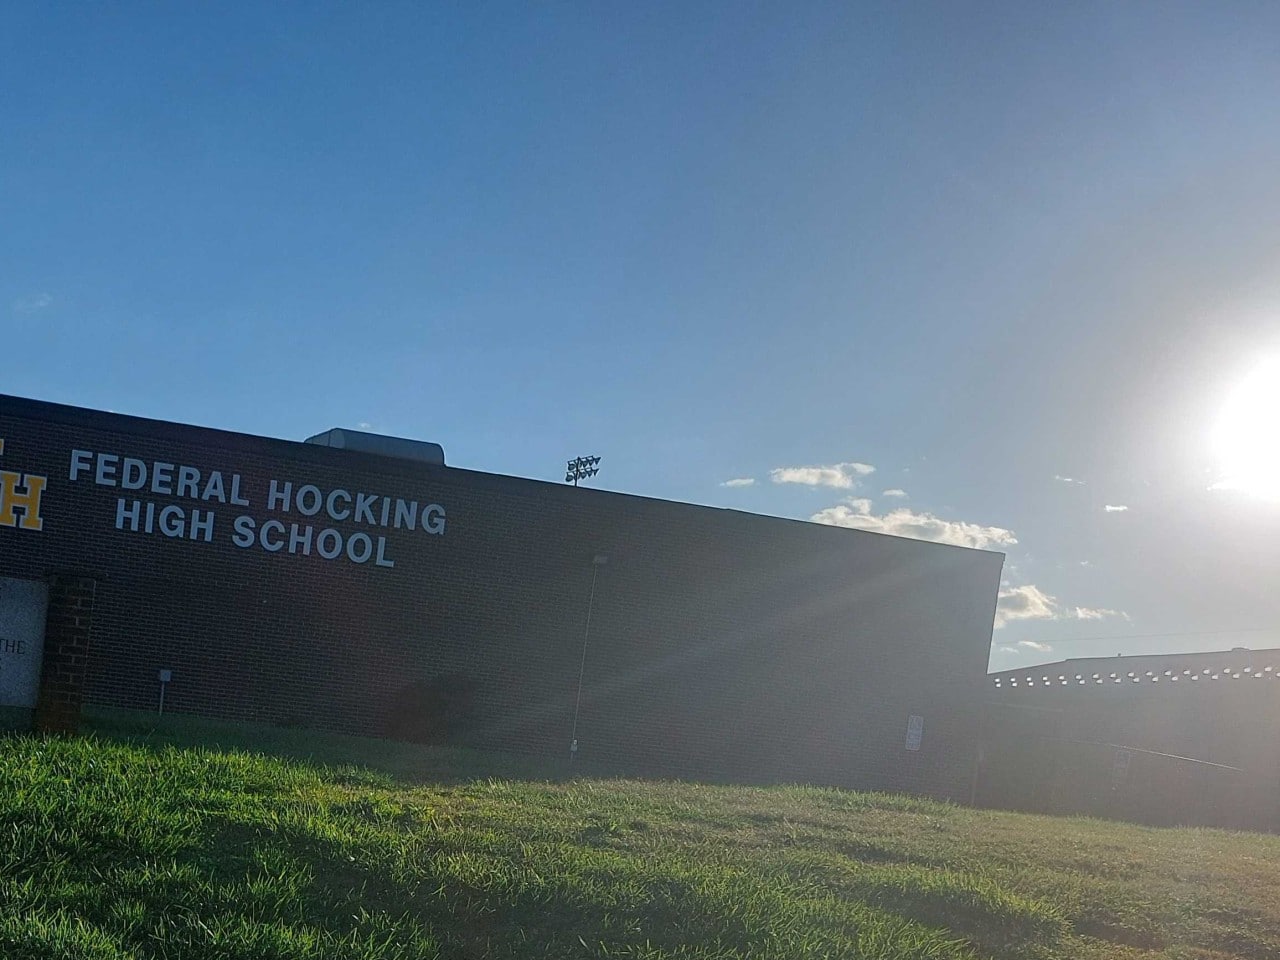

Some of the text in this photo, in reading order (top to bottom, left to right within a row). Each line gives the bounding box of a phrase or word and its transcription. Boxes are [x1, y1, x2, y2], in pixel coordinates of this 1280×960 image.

[69, 448, 447, 536] FEDERAL HOCKING
[115, 498, 395, 568] HIGH SCHOOL
